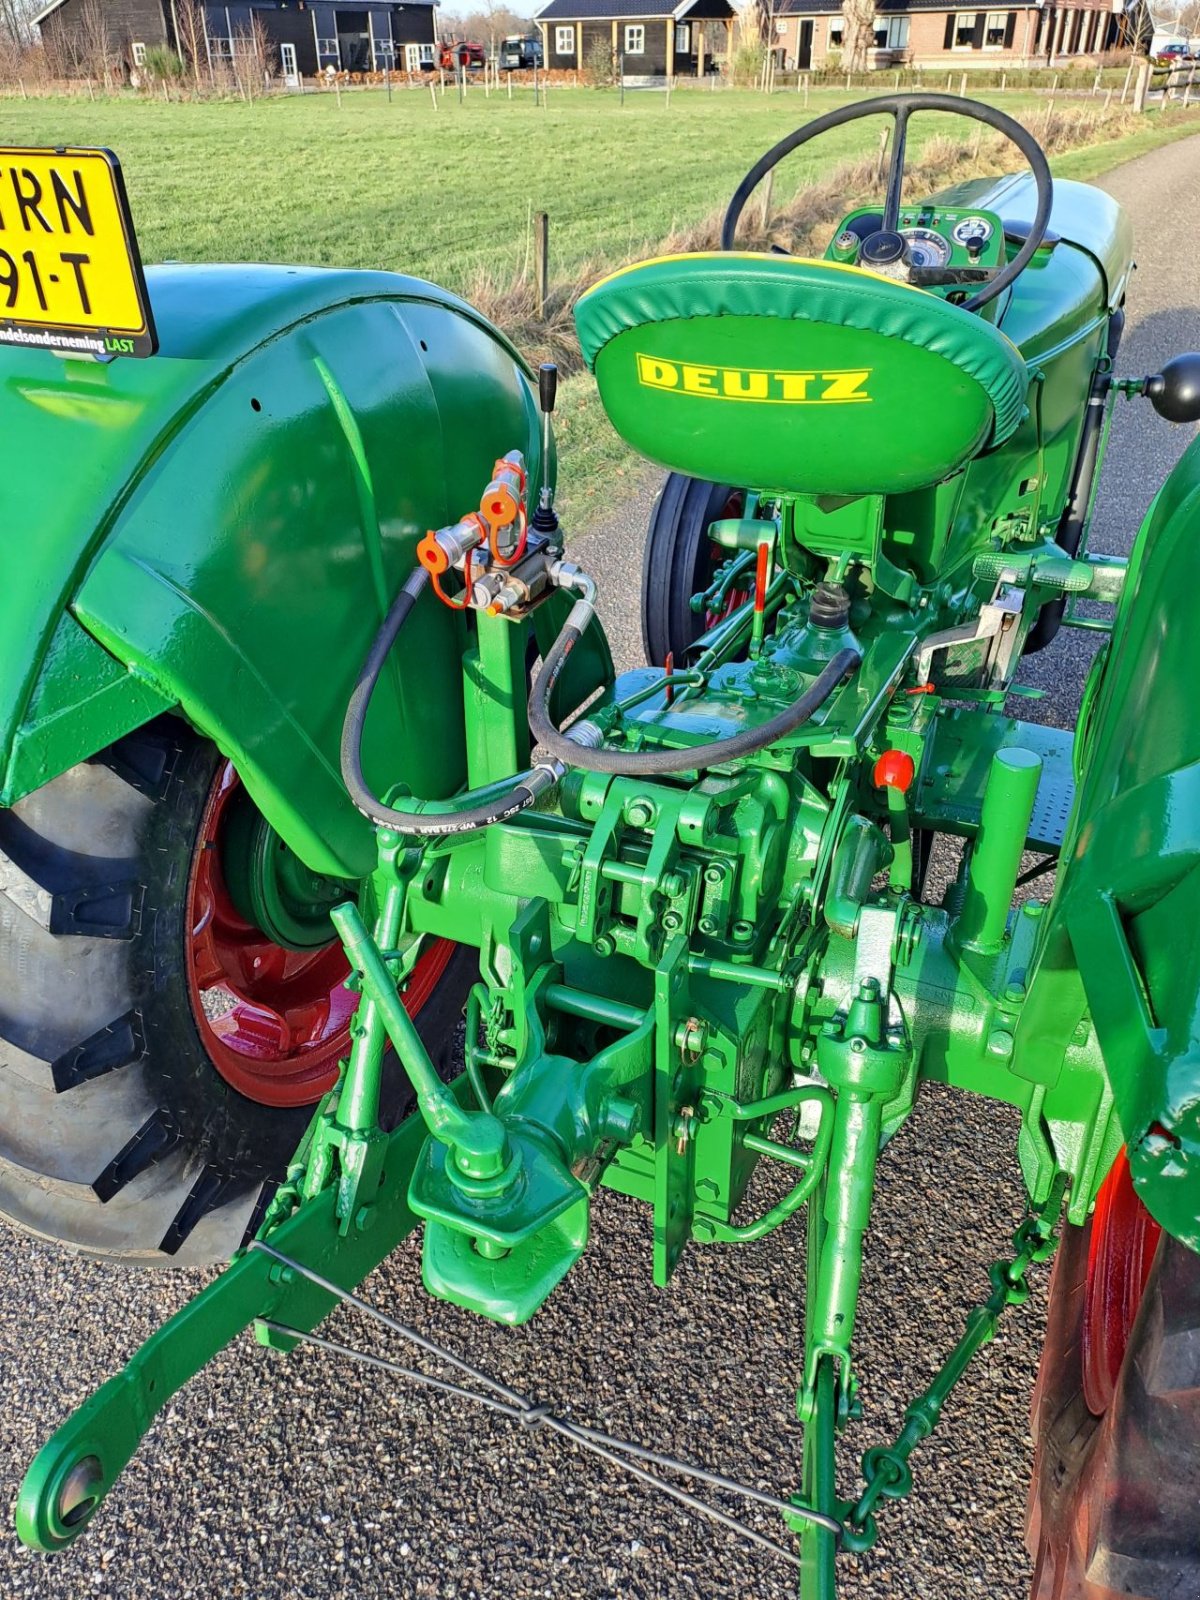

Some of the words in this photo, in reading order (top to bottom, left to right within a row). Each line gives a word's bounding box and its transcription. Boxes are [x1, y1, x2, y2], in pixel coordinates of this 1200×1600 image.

[0, 168, 95, 236] RN
[105, 337, 134, 353] LAST
[640, 358, 869, 400] DEUTZ
[486, 815, 498, 824] 12
